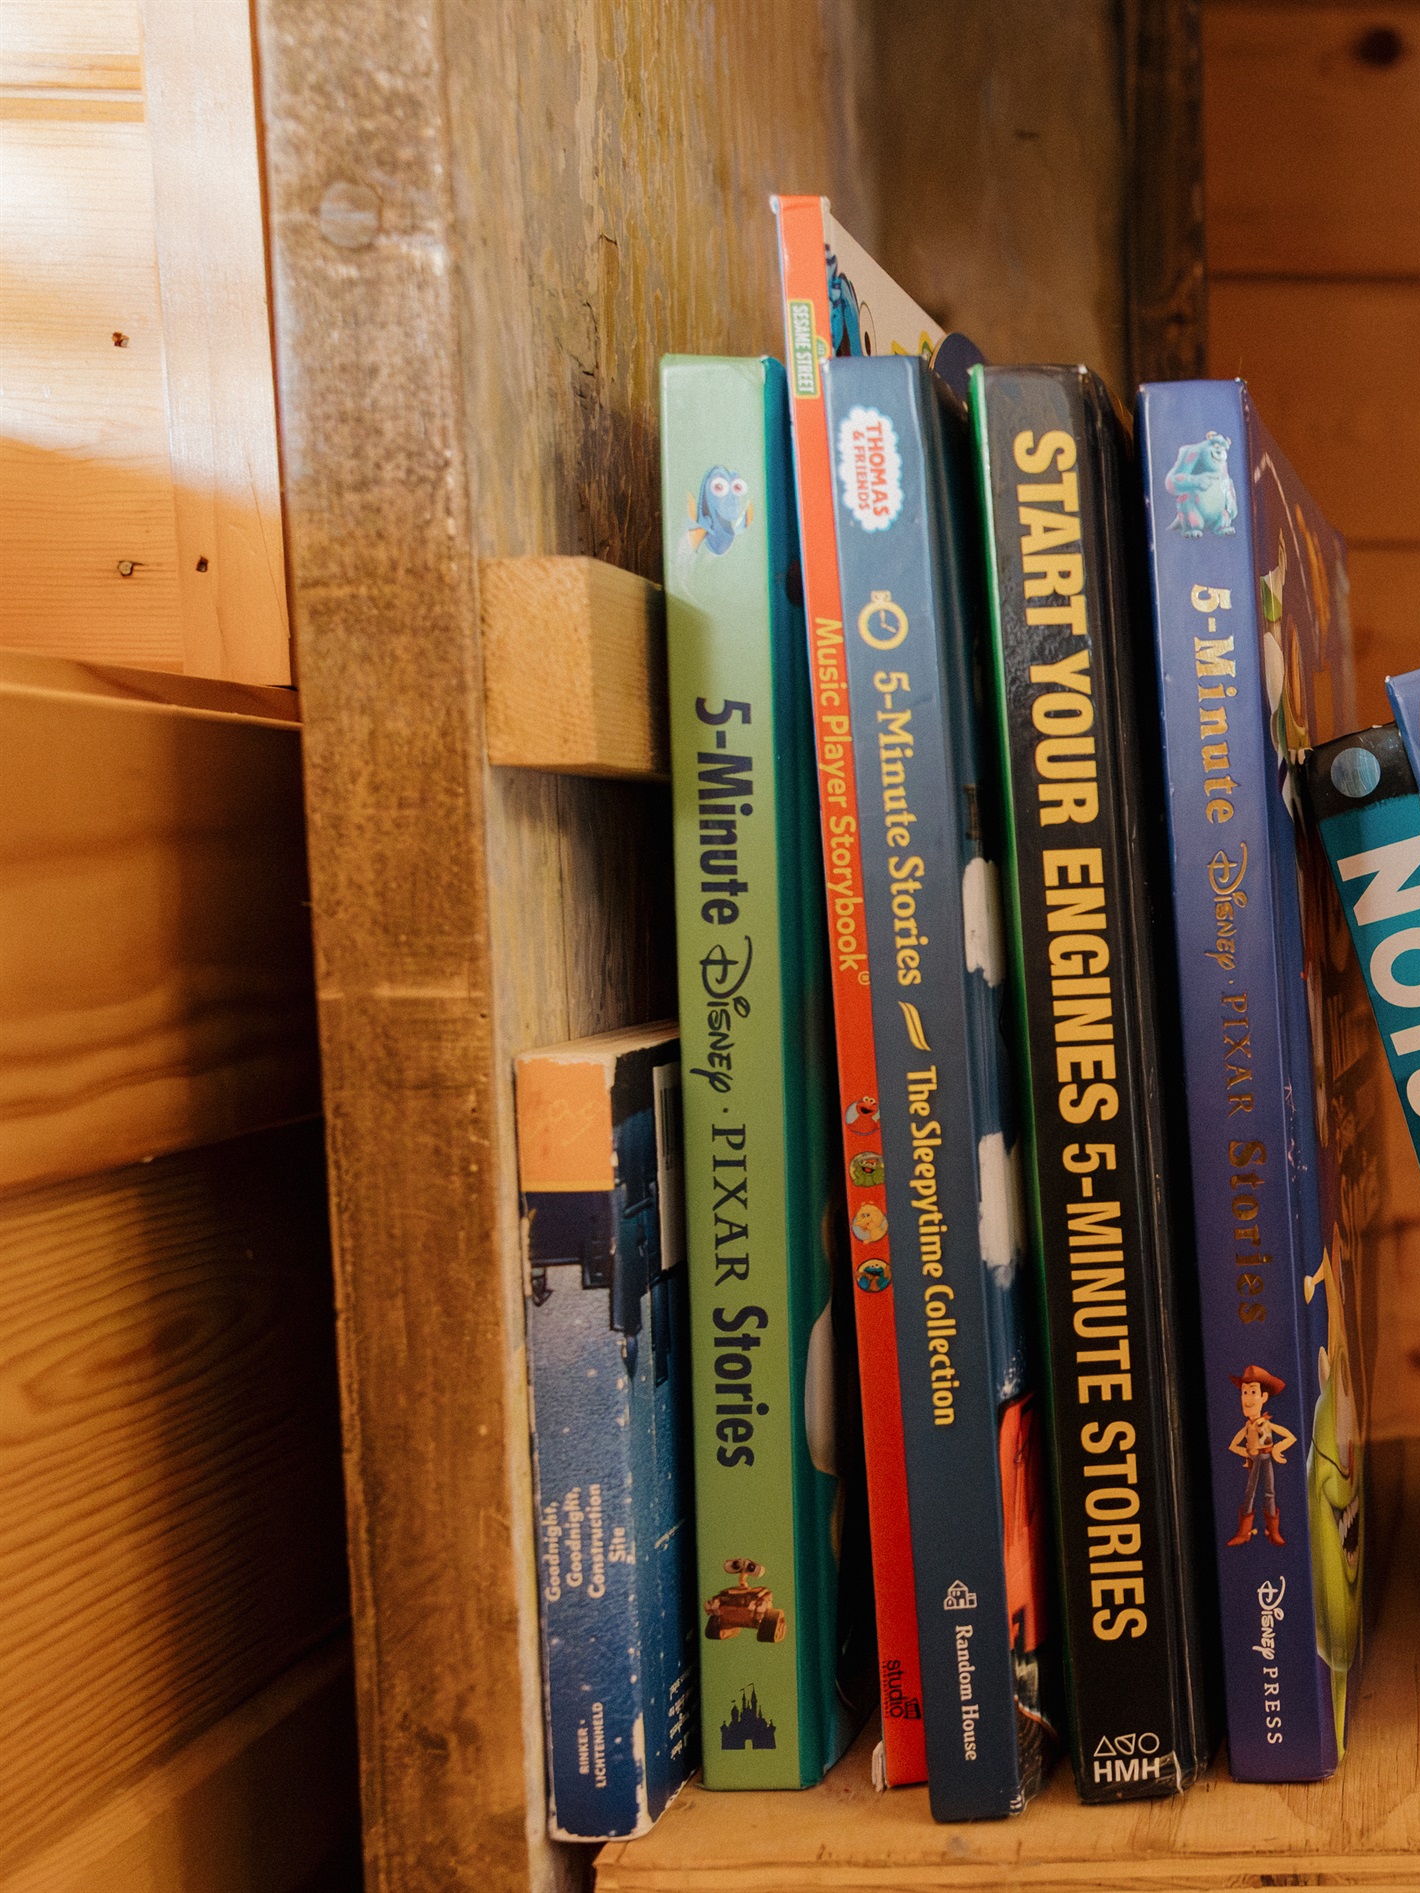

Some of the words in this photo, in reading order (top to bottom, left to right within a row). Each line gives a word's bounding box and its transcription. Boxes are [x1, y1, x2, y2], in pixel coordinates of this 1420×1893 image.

[793, 304, 812, 350] SESAME
[796, 351, 815, 394] STREET
[852, 430, 864, 440] &
[854, 446, 870, 511] FRIENDS
[866, 421, 890, 517] THOMAS
[1013, 430, 1088, 636] START
[815, 617, 848, 707] Music
[1190, 583, 1240, 824] 5-Minute
[815, 714, 853, 808] Player
[873, 670, 919, 848] 5-Minute
[1029, 649, 1100, 828] YOUR
[695, 697, 753, 925] 5-Minute
[888, 856, 929, 987] Stories
[1042, 847, 1119, 1125] ENGINES
[906, 1065, 938, 1117] The
[1221, 991, 1254, 1119] PIXAR
[712, 1123, 750, 1286] PIXAR
[908, 1124, 948, 1278] Sleepytime
[1227, 1140, 1273, 1324] Stories
[1062, 1142, 1133, 1404] 5-MINUTE
[712, 1305, 769, 1467] Stories
[923, 1284, 961, 1426] Collection
[541, 1501, 562, 1601] Goodnight,
[563, 1487, 584, 1588] Goodnight,
[585, 1483, 606, 1599] Construction
[608, 1527, 627, 1562] Site
[1080, 1420, 1148, 1641] STORIES
[887, 1659, 909, 1718] studio
[955, 1624, 975, 1701] Random
[1263, 1667, 1283, 1744] PRESS
[577, 1727, 590, 1774] RINKER
[592, 1702, 607, 1788] LICHTENHELD
[961, 1704, 979, 1761] House
[1093, 1757, 1160, 1783] HMH
